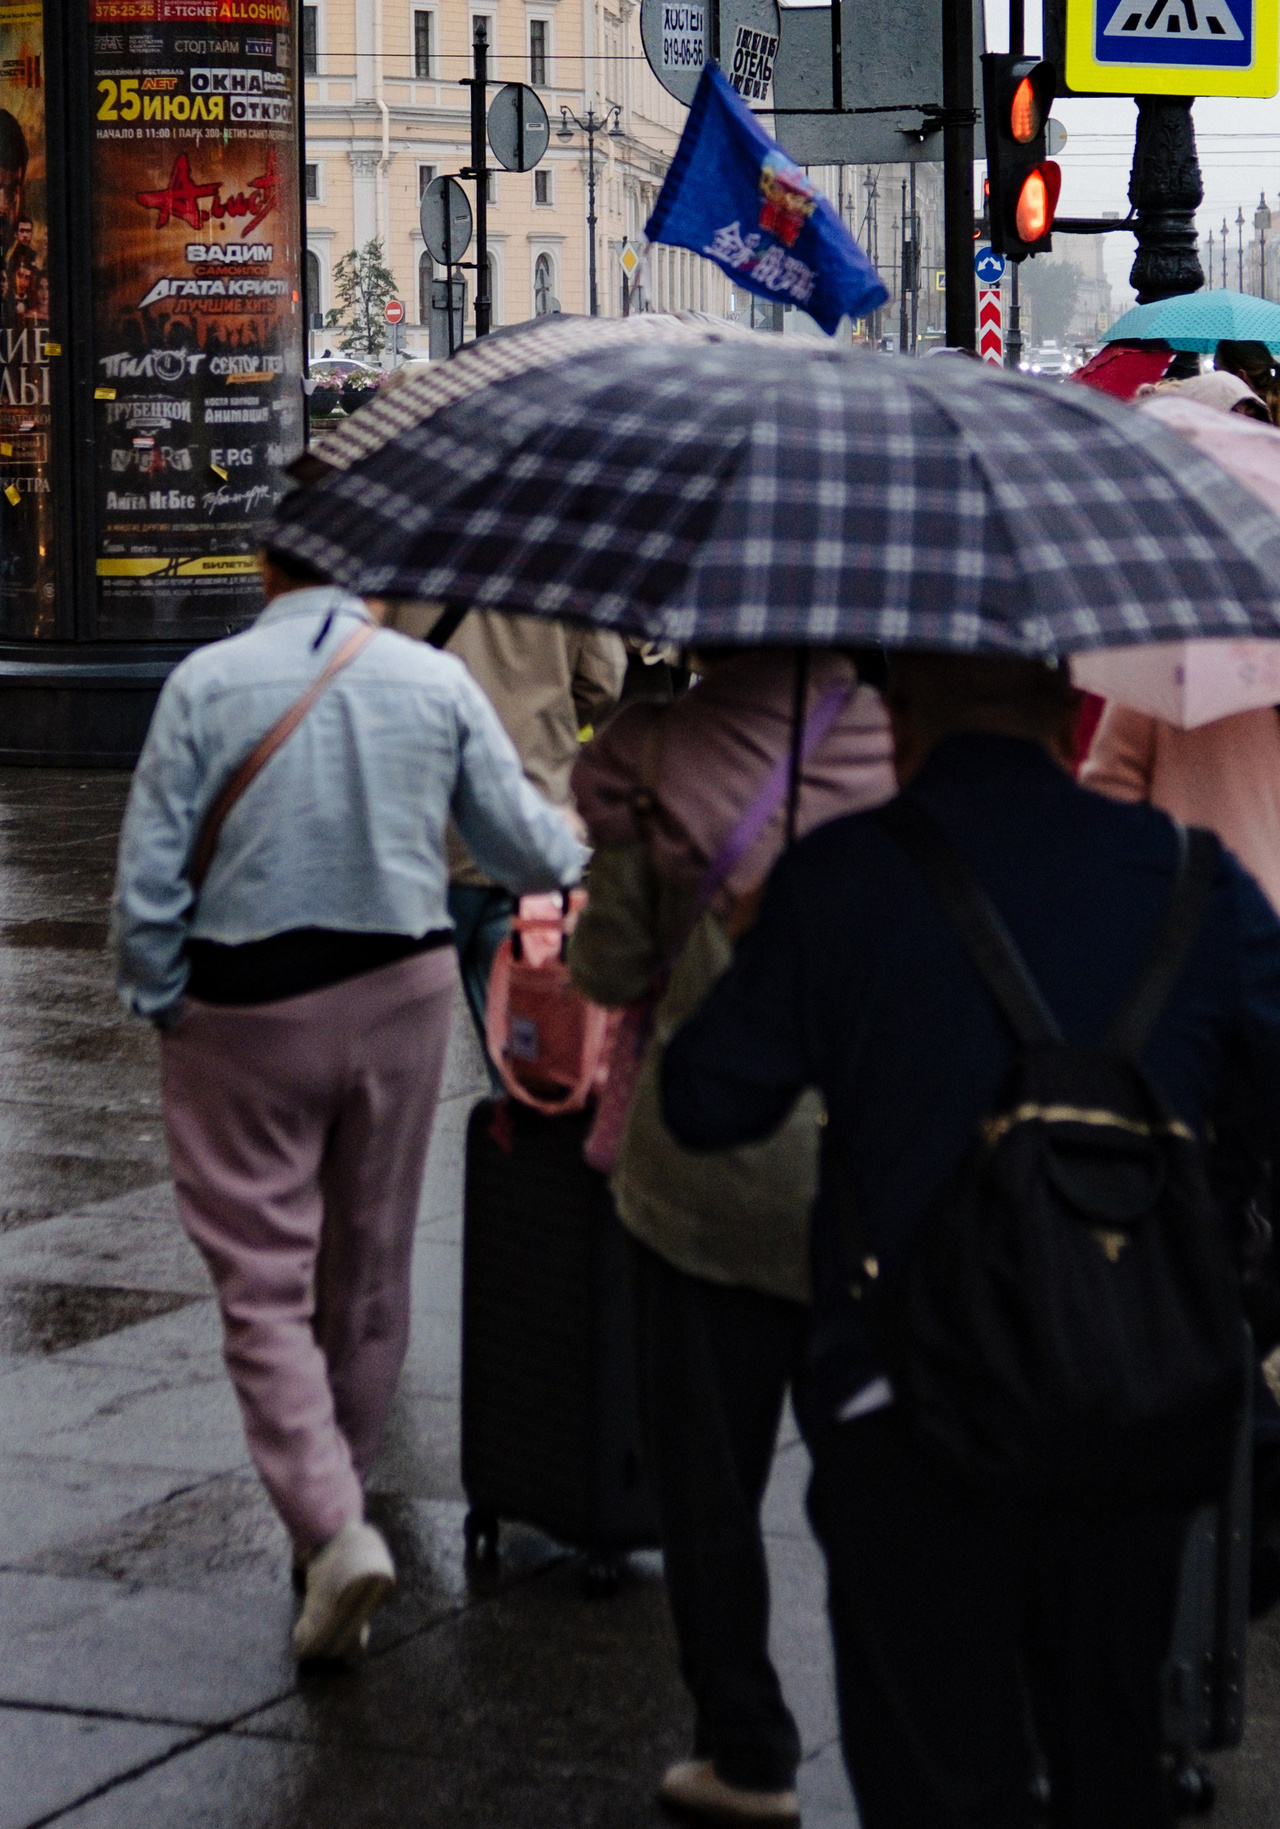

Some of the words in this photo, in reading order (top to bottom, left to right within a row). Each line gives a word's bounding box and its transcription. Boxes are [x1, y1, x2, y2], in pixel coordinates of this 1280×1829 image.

[95, 5, 155, 17] 375-25-25
[163, 6, 218, 17] E-TICKET
[209, 40, 240, 54] ТАЙМ
[664, 38, 703, 66] 919-06-56
[142, 68, 184, 76] ФЕСТИВАЛЬ
[733, 48, 772, 81] ОТЕЛЬ
[191, 72, 261, 92] ОКНА
[96, 79, 141, 121] 25
[141, 77, 178, 90] ЛЕТ
[143, 95, 224, 121] ИЮЛЯ
[96, 129, 134, 139] НАЧАЛО
[136, 129, 142, 138] В
[145, 129, 171, 139] 11:00
[178, 128, 203, 139] ПАРК
[186, 244, 273, 263] ВАДИМ
[138, 278, 226, 309] АГАТА
[0, 327, 50, 364] ИЕ
[99, 347, 206, 381] ПИЛОТ
[105, 401, 192, 424] ТРУБЕЦКОЙ
[202, 560, 254, 570] БИЛЕТЫ
